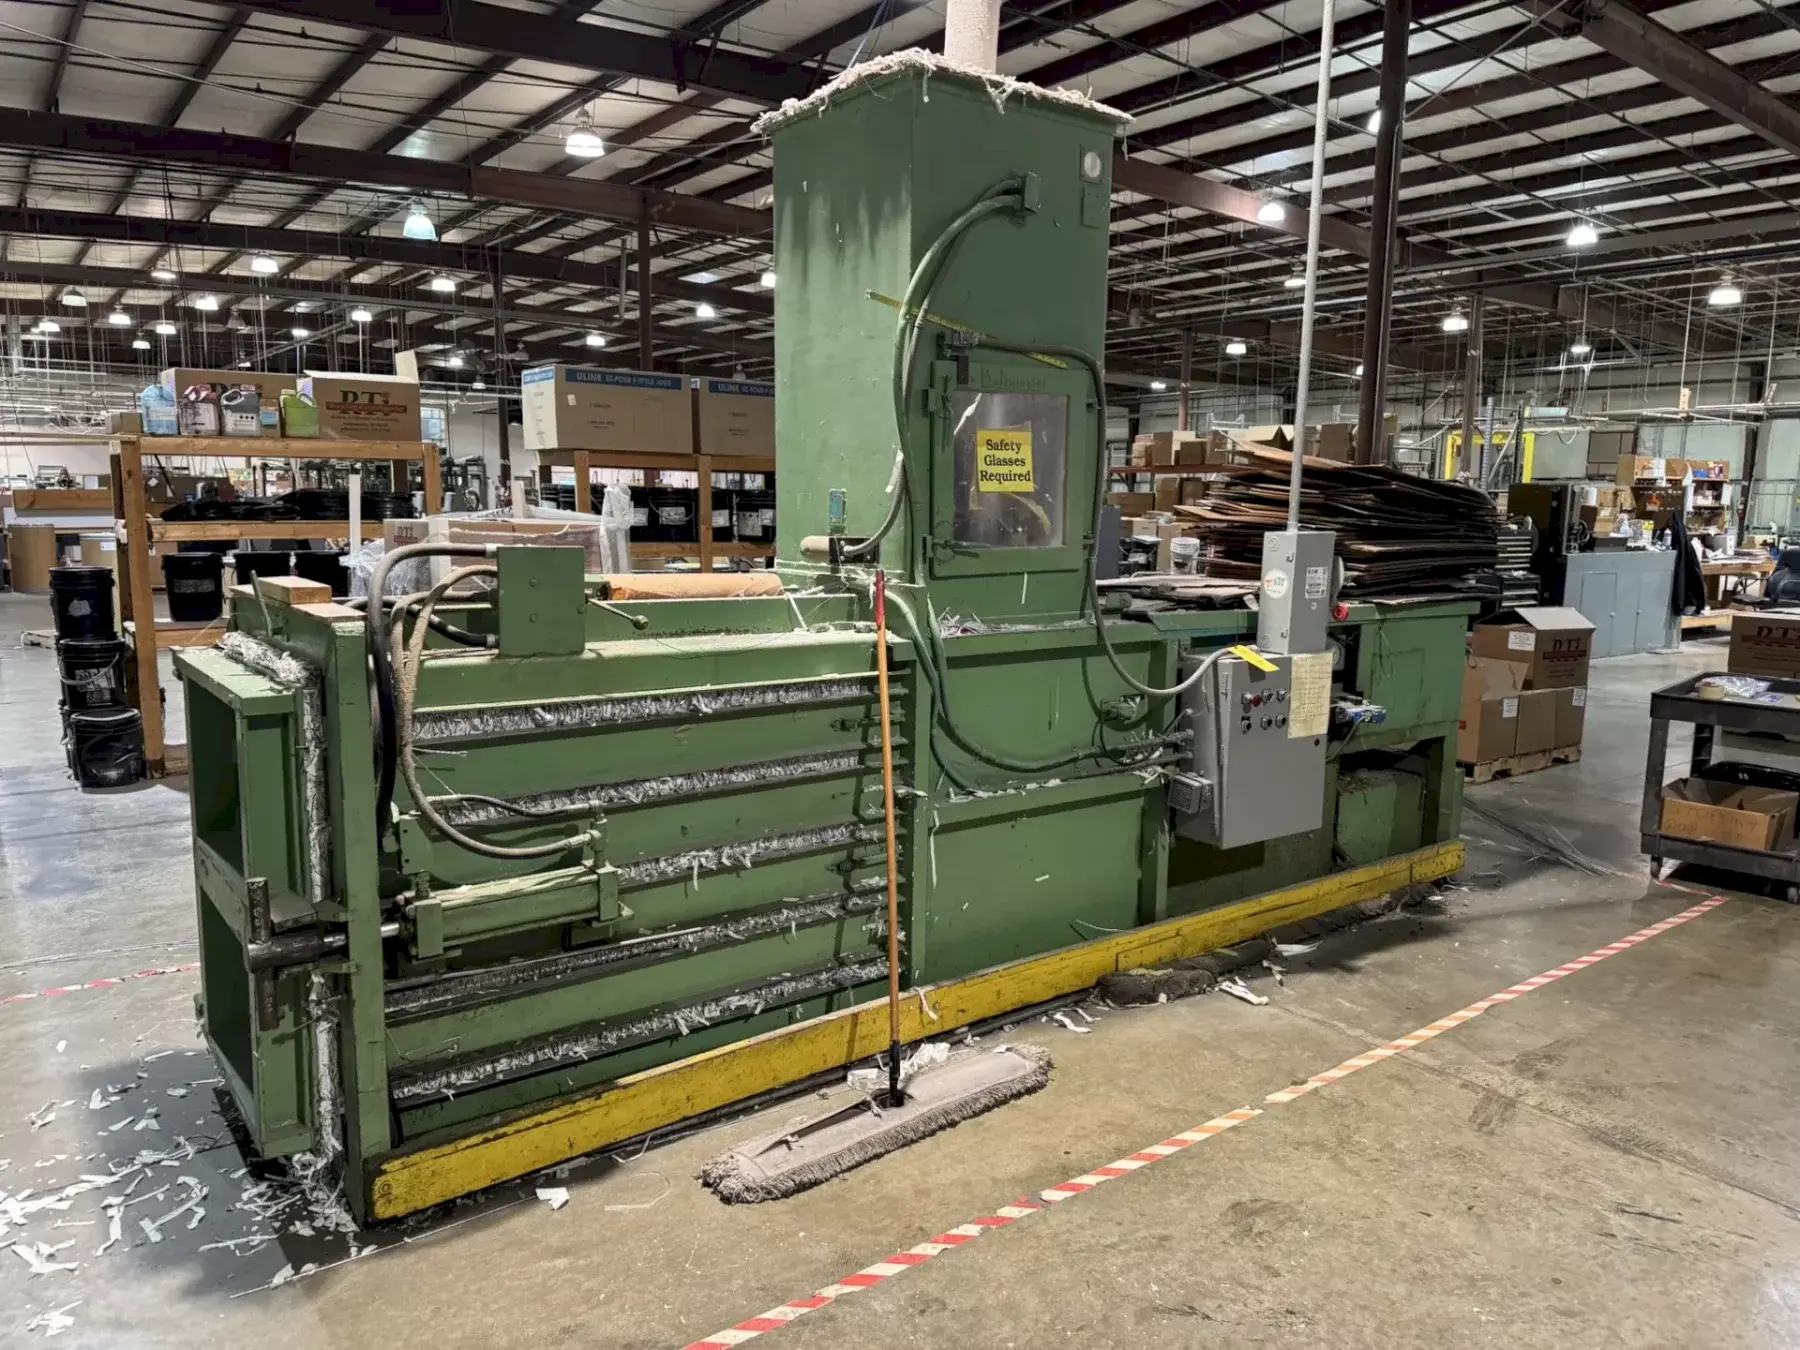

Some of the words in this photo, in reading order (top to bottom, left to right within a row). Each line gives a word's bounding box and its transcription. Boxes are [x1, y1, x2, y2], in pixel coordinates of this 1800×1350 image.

[576, 372, 602, 382] ULINE
[717, 383, 740, 392] ULINE
[986, 439, 1021, 454] Safety
[984, 454, 1026, 467] Glasses
[980, 470, 1031, 485] Required
